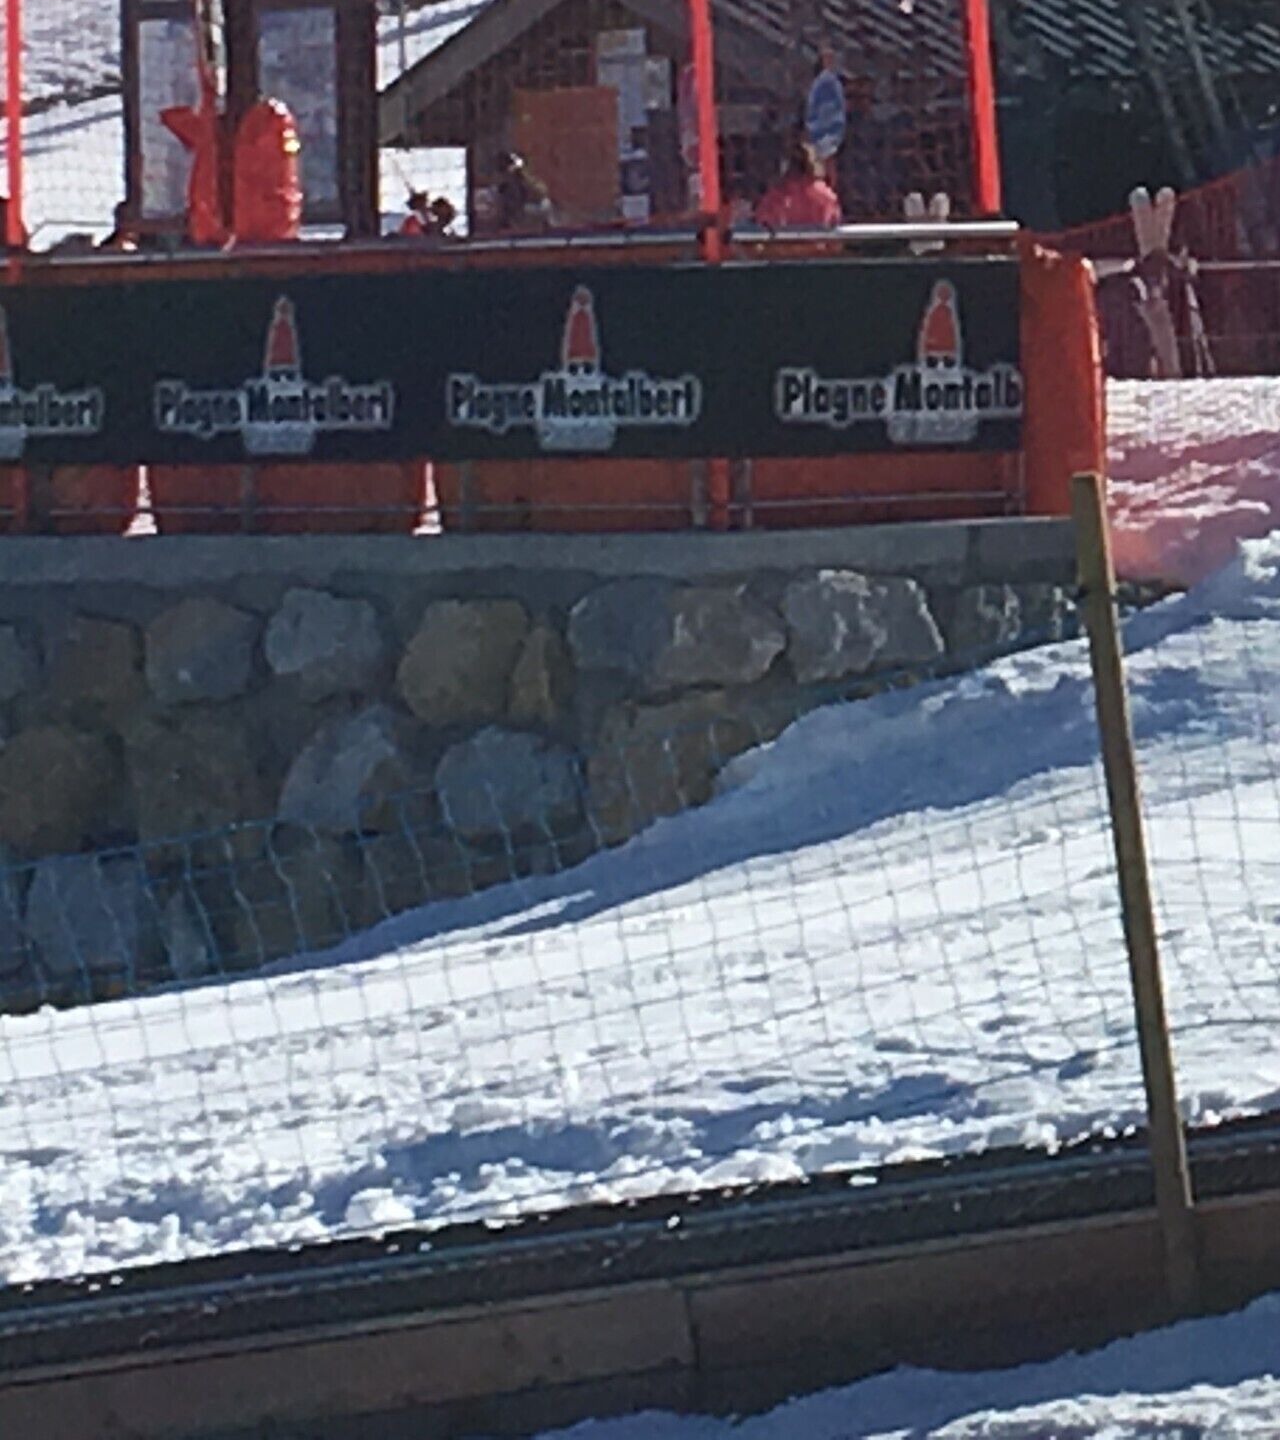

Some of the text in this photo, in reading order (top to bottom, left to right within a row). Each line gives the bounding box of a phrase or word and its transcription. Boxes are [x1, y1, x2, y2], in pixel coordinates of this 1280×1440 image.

[161, 381, 391, 433] Plagne Montalbert
[452, 375, 693, 428] Plagne Montalbert
[782, 372, 887, 423] Plagne
